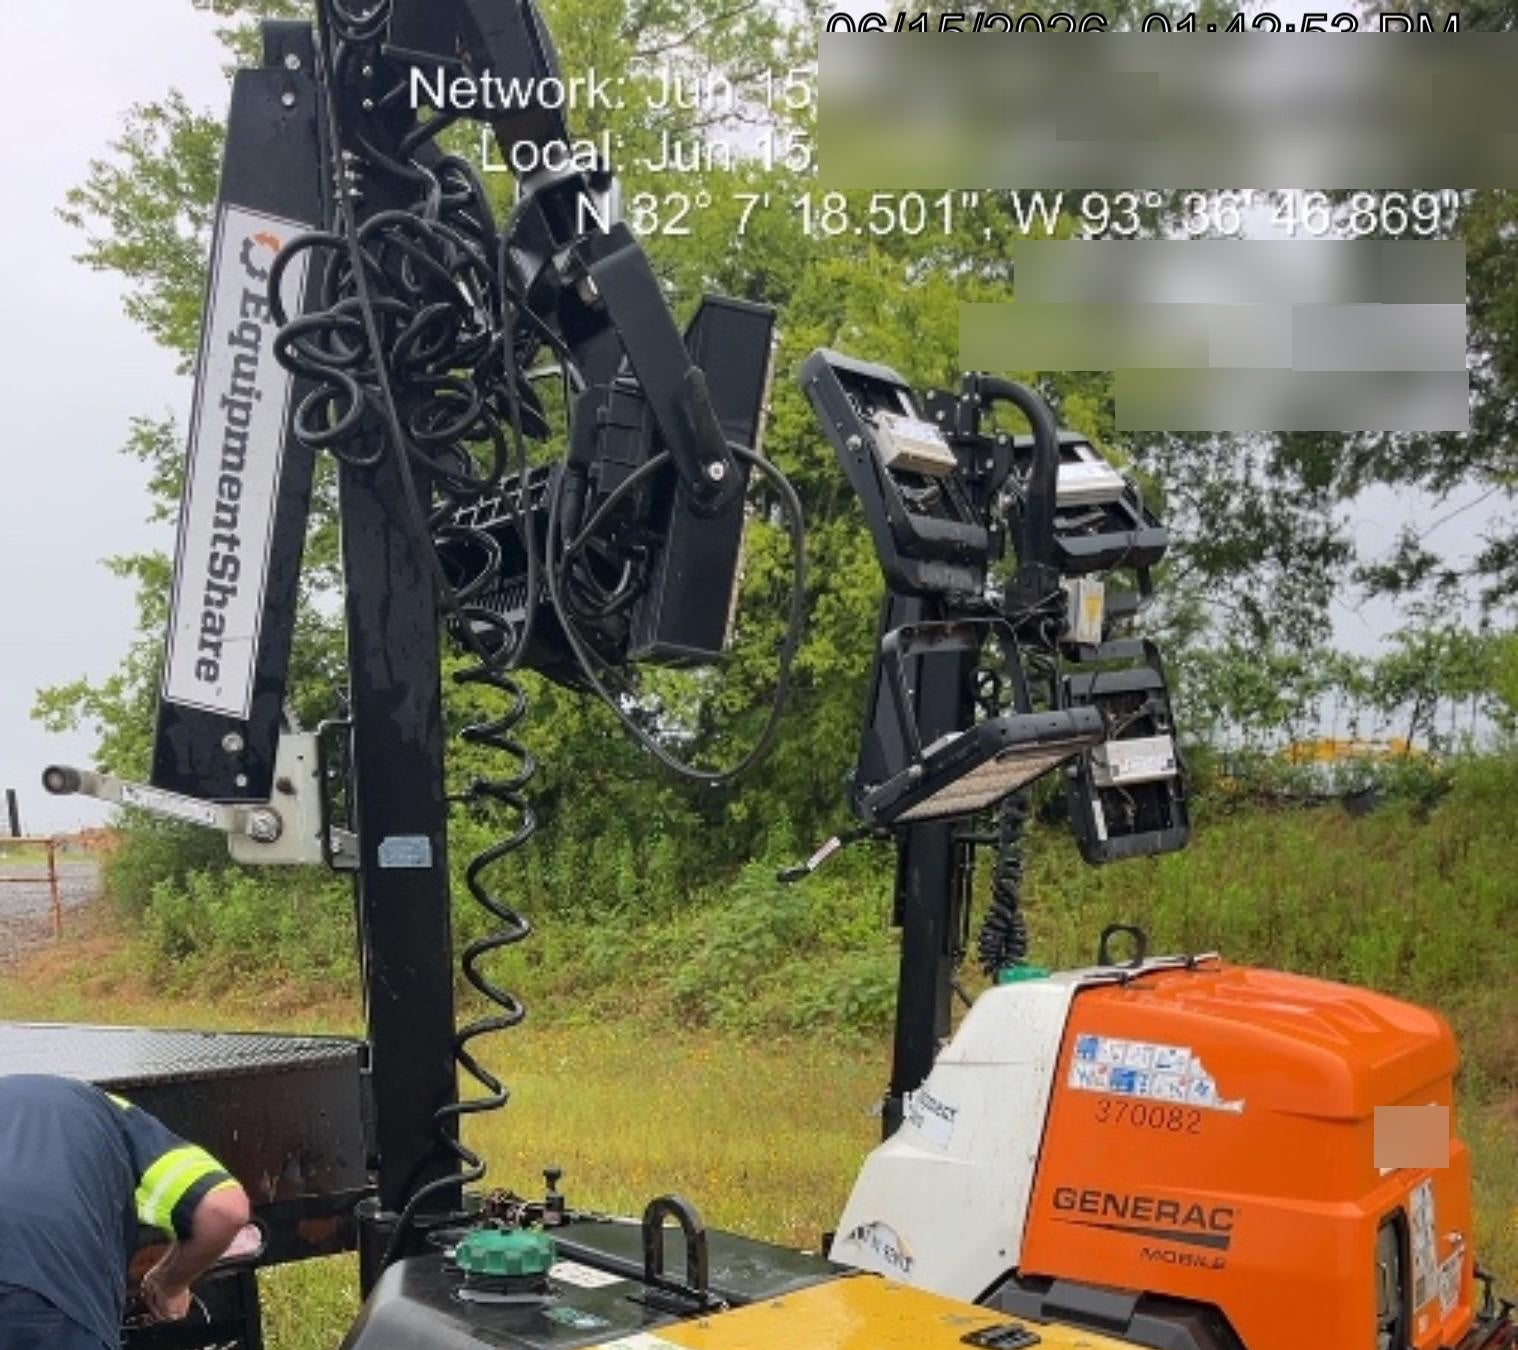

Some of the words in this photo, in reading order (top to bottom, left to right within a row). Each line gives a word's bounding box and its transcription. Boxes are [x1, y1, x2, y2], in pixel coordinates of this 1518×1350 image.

[194, 287, 272, 684] EquipmentShare
[1094, 1099, 1202, 1135] 370082
[1053, 1186, 1235, 1232] GENERAC
